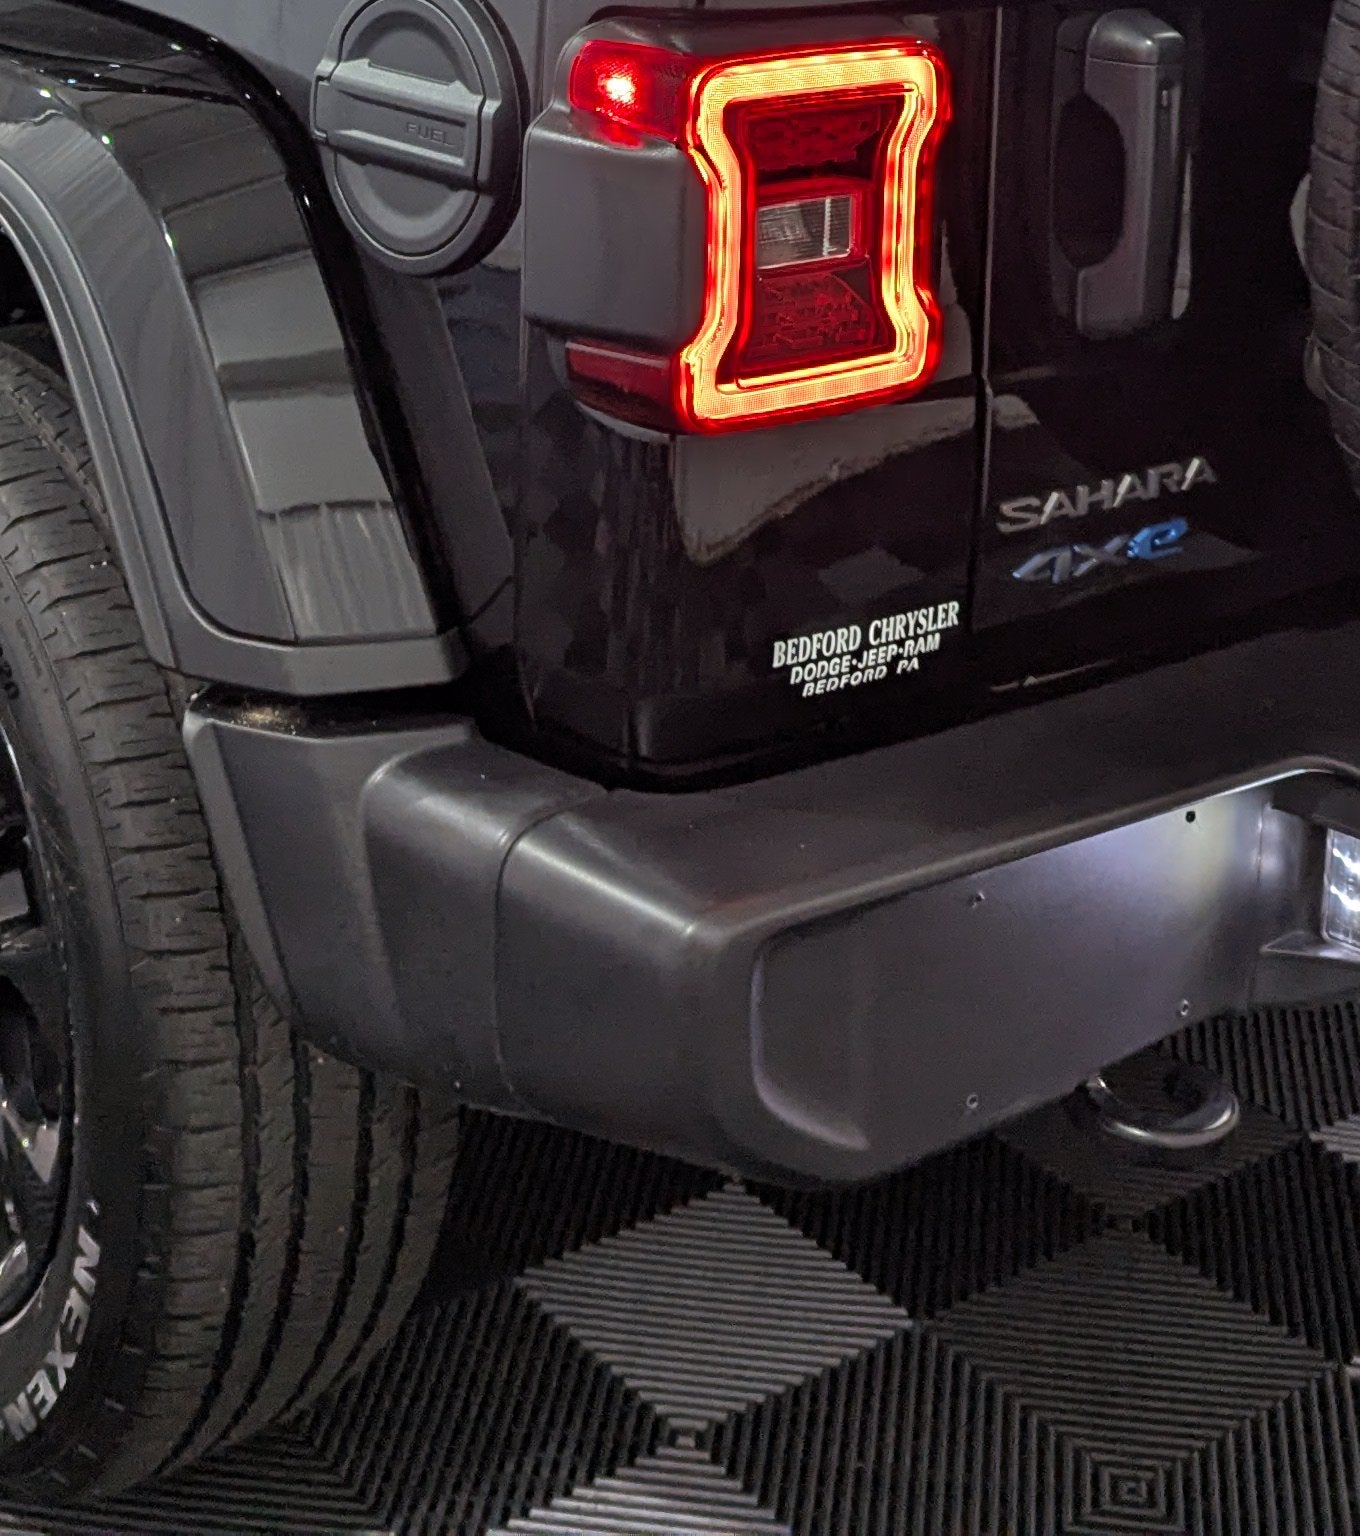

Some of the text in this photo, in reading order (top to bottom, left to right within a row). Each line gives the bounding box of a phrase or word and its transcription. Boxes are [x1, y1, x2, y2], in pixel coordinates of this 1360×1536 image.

[405, 121, 457, 147] FUEL
[995, 455, 1218, 534] SAHARA
[772, 600, 960, 668] BEDFORD CHRYSLER
[801, 656, 920, 698] BEDFORD PA
[2, 1225, 101, 1442] NEXEN
